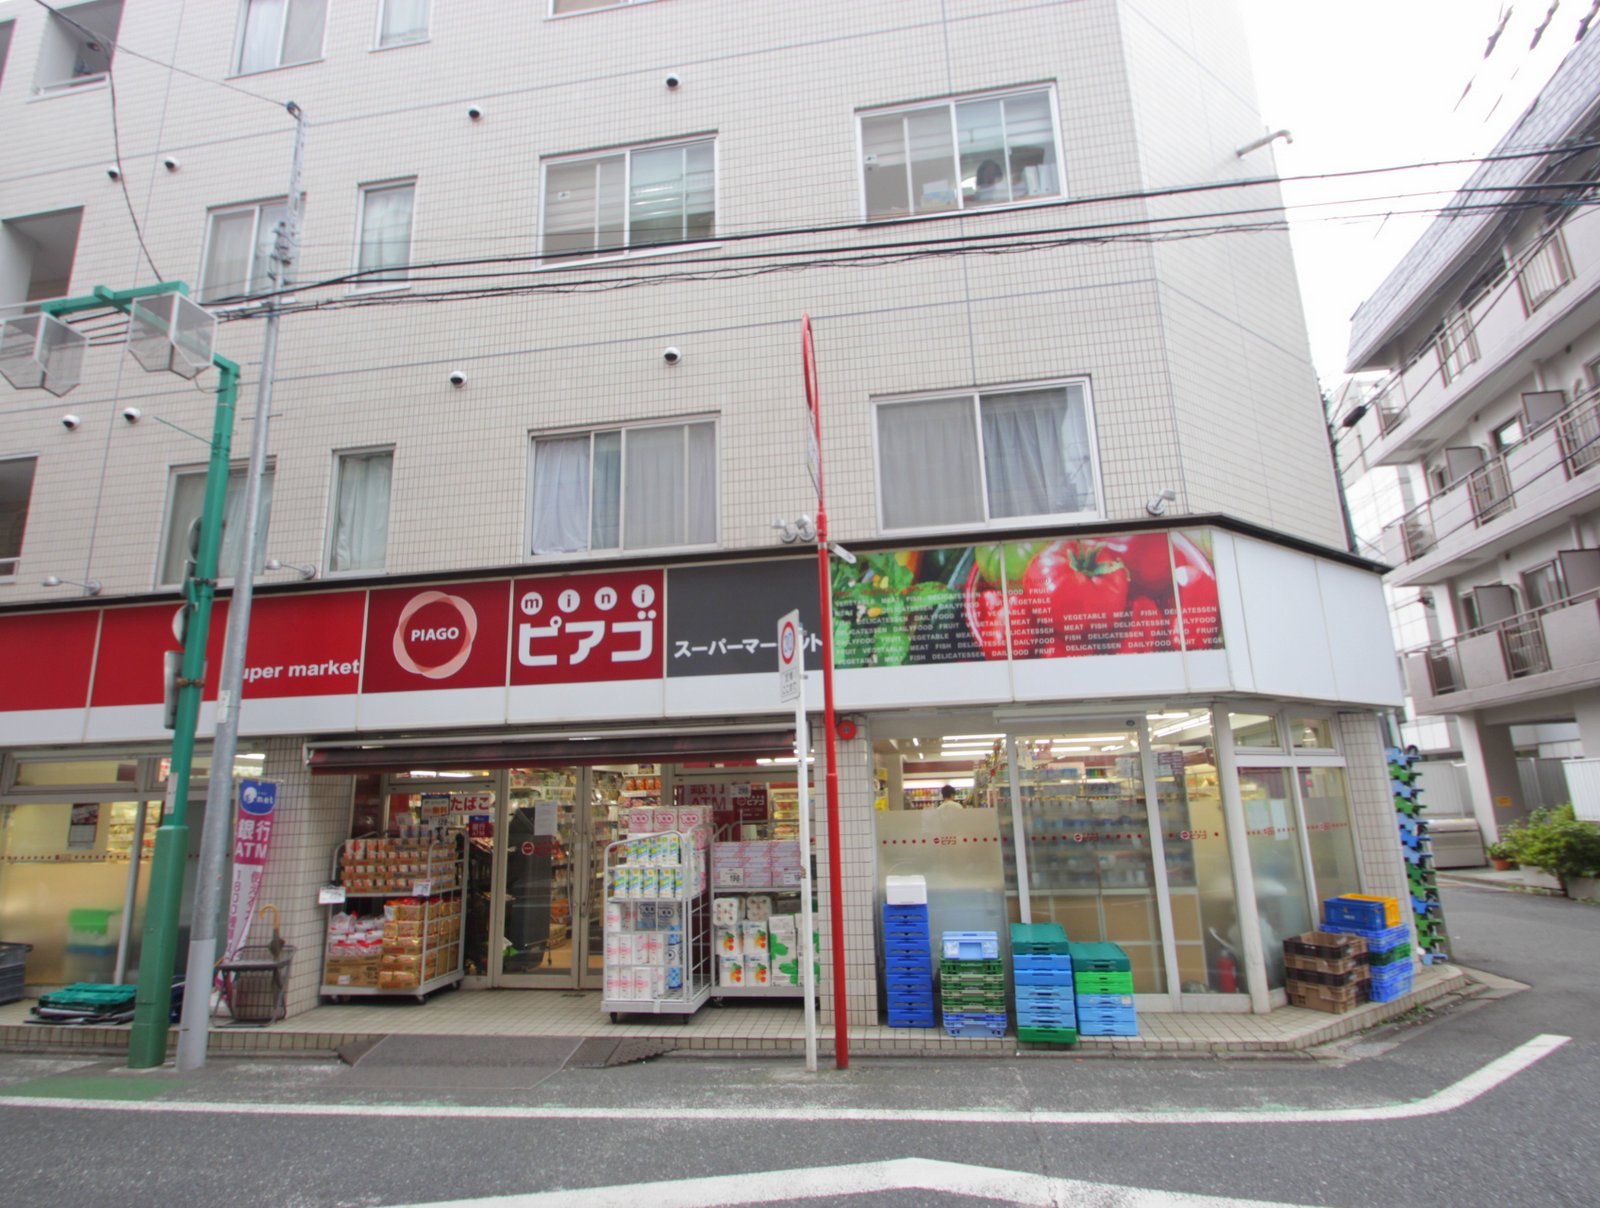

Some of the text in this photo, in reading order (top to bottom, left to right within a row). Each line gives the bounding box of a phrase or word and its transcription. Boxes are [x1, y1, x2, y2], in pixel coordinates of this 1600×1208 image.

[523, 588, 648, 611] mini
[1032, 607, 1052, 615] MEAT
[1063, 612, 1107, 622] VEGETABLE
[1112, 610, 1134, 619] MEAT
[1140, 609, 1158, 617] FISH
[1010, 618, 1031, 626] MEAT
[1063, 623, 1084, 632] MEAT
[1090, 622, 1108, 630] FISH
[1113, 618, 1171, 630] DELICATESSEN
[410, 626, 460, 642] PIAGO
[518, 609, 657, 667] ピアゴ
[907, 632, 950, 642] VEGETABLE
[955, 631, 977, 639] MEAT
[1064, 633, 1082, 642] FISH
[1087, 630, 1144, 641] DELICATESSEN
[1195, 626, 1218, 635] FRUIT
[673, 633, 823, 659] スーパーマート
[910, 644, 930, 652] MEAT
[935, 642, 952, 650] FISH
[1013, 637, 1056, 647] DAILYFOOD
[1065, 643, 1122, 652] DELICATESSEN
[1127, 639, 1172, 649] DAILYFOOD
[909, 653, 927, 661] FISH
[931, 651, 986, 660] DELICATESSEN
[991, 648, 1030, 658] DAILOOD
[1034, 646, 1056, 655] FRUIT
[242, 658, 361, 683] uper market
[450, 796, 489, 811] たばこ
[238, 819, 271, 842] 銀行
[234, 842, 268, 859] ATM
